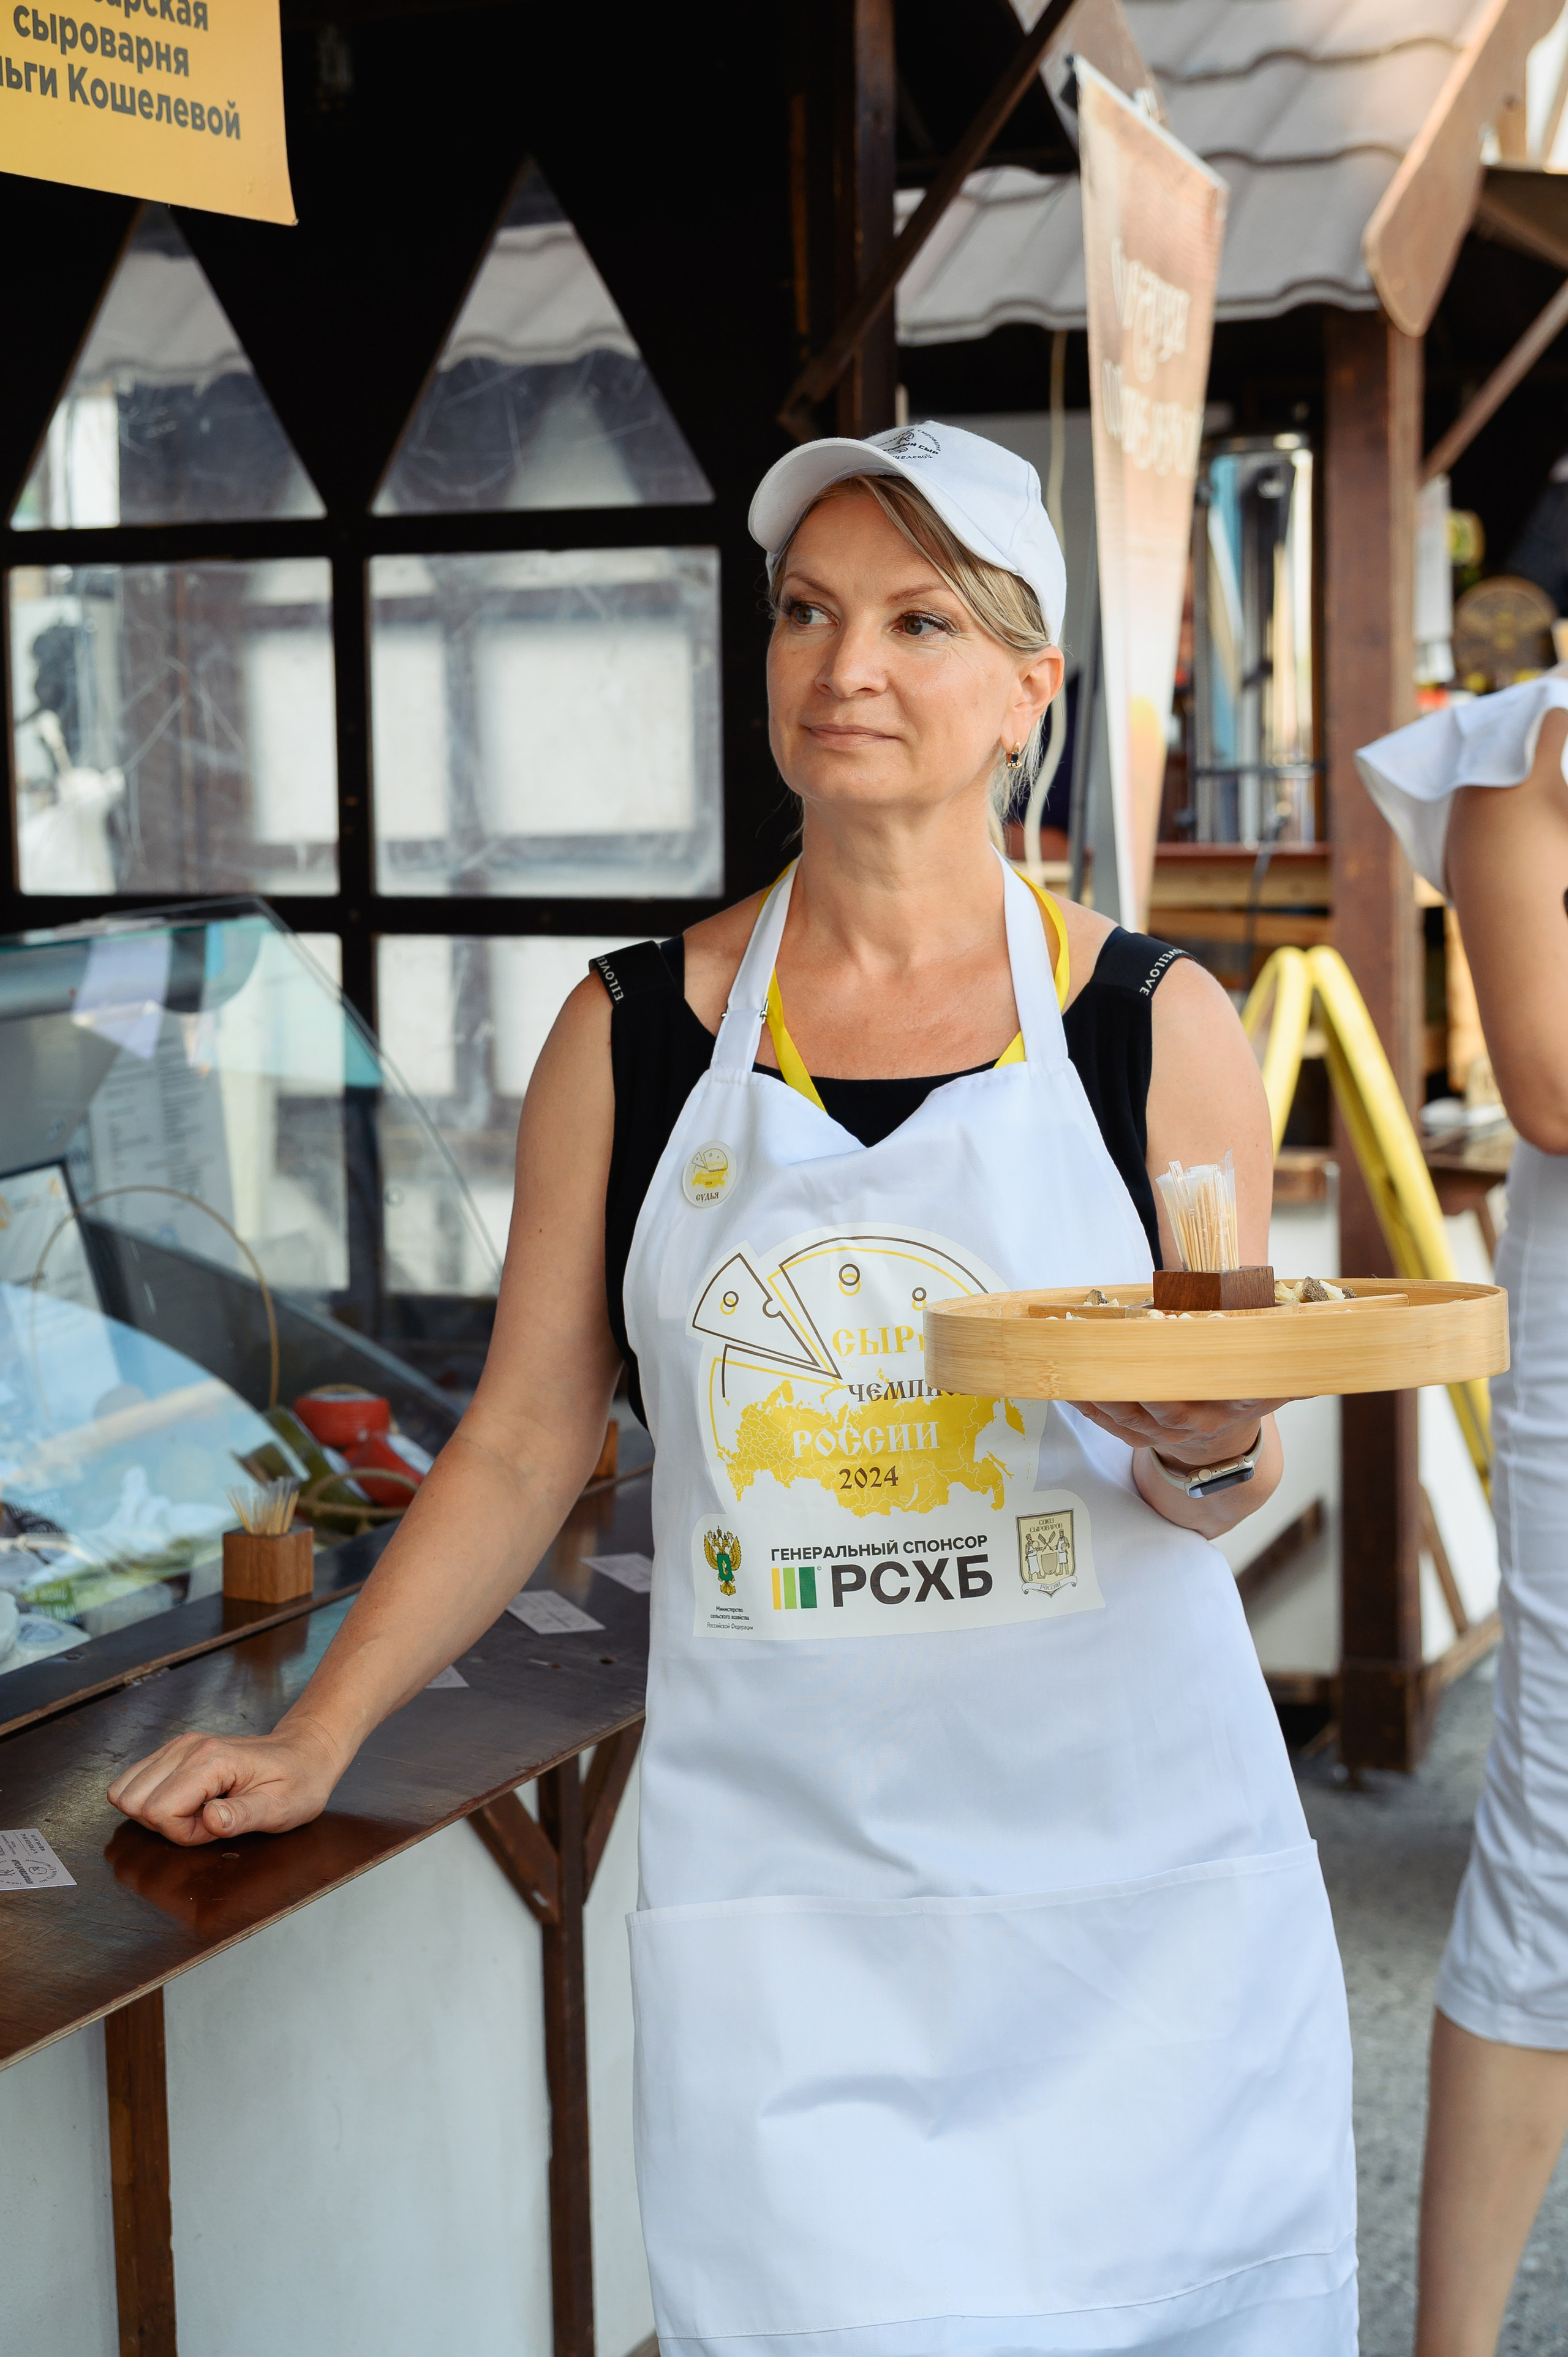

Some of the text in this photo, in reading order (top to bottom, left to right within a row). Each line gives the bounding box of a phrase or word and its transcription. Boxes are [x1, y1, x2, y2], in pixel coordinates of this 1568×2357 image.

[13, 5, 189, 77] сыроварня
[0, 55, 241, 140] ьги Кошелевой
[918, 445, 939, 454] СЫР
[696, 1192, 719, 1202] СУДЬЯ
[792, 1422, 941, 1458] РОССИИ
[839, 1466, 899, 1490] 2024
[1030, 1523, 1063, 1533] СЫРОВАРОВ
[771, 1534, 987, 1561] ГЕНЕРАЛЬНЫЙ СПОНСОР
[831, 1553, 993, 1608] РСХБ
[1040, 1582, 1061, 1591] РОССИИ
